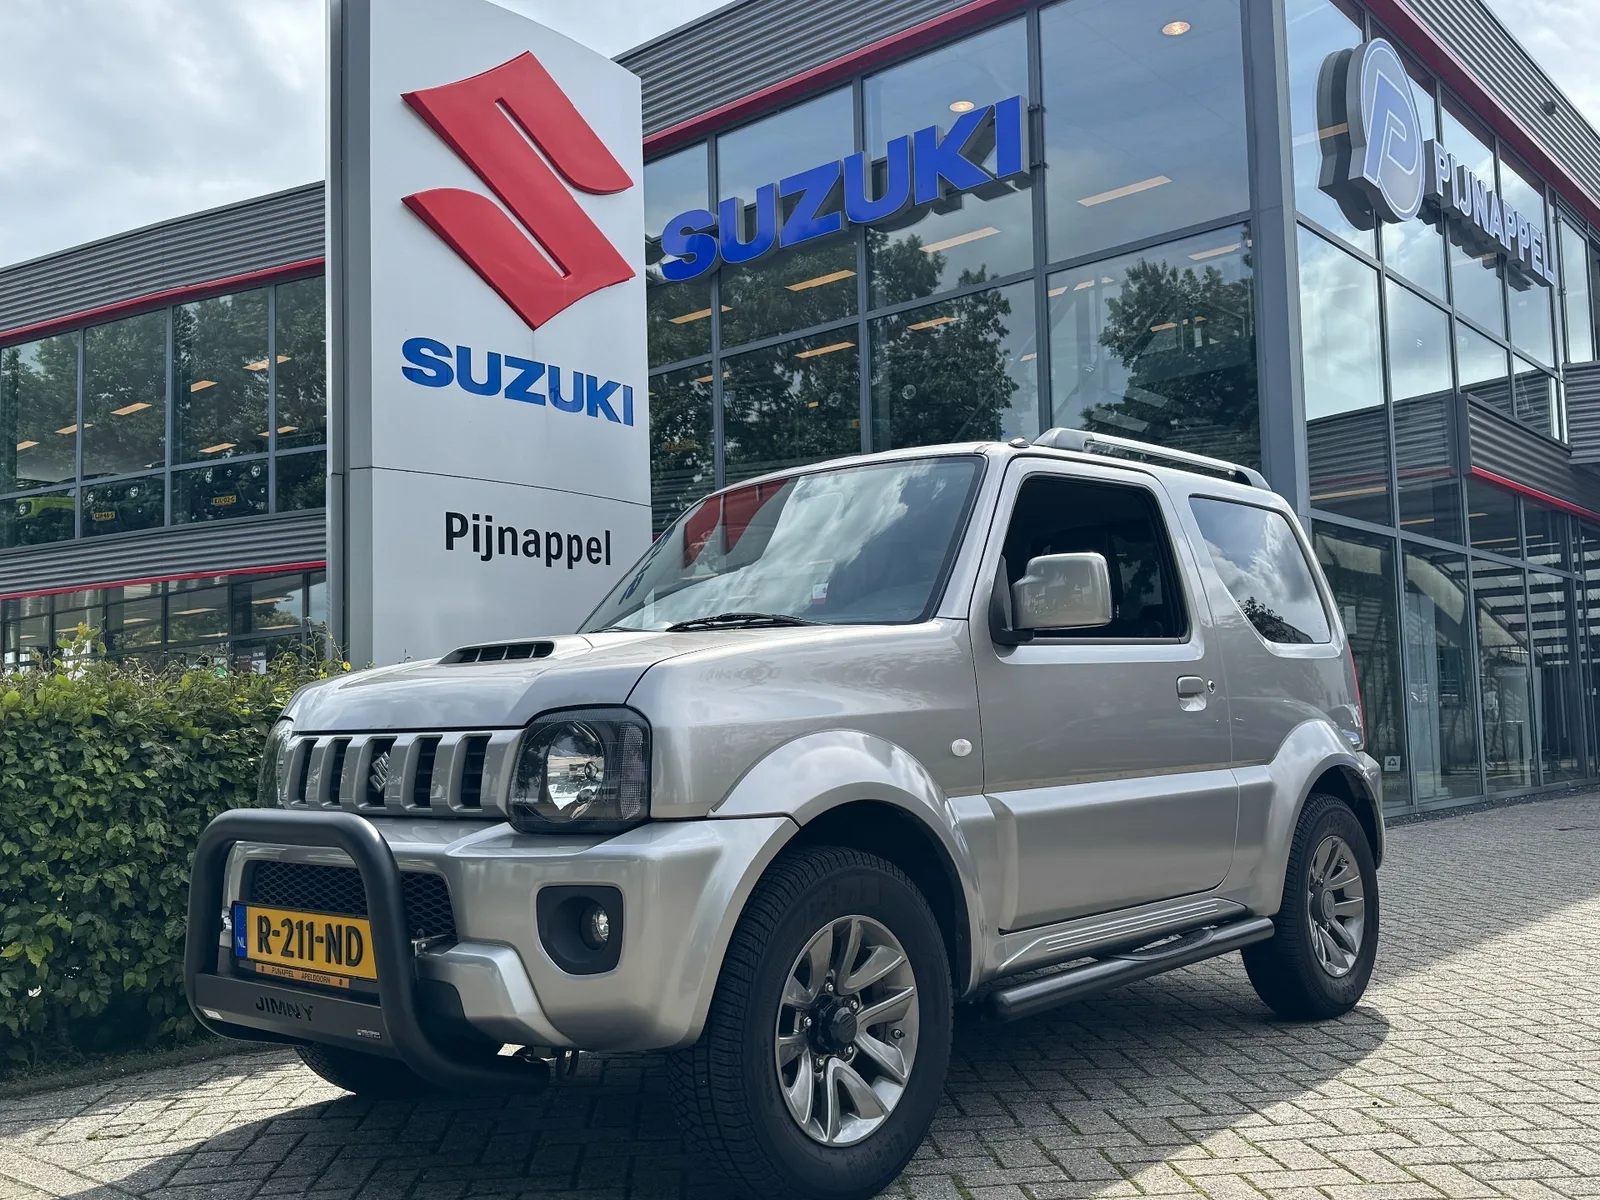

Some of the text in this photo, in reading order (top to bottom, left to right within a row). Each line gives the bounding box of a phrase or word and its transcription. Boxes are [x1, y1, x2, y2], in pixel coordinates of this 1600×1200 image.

[661, 95, 1025, 282] SUZUKI
[1433, 139, 1555, 287] PIJNAPPEL
[401, 337, 634, 427] SUZUKI
[445, 511, 612, 570] Pijnappel
[256, 914, 364, 968] R-211-ND
[300, 972, 331, 984] APELDOORN
[255, 995, 314, 1022] JIMNY
